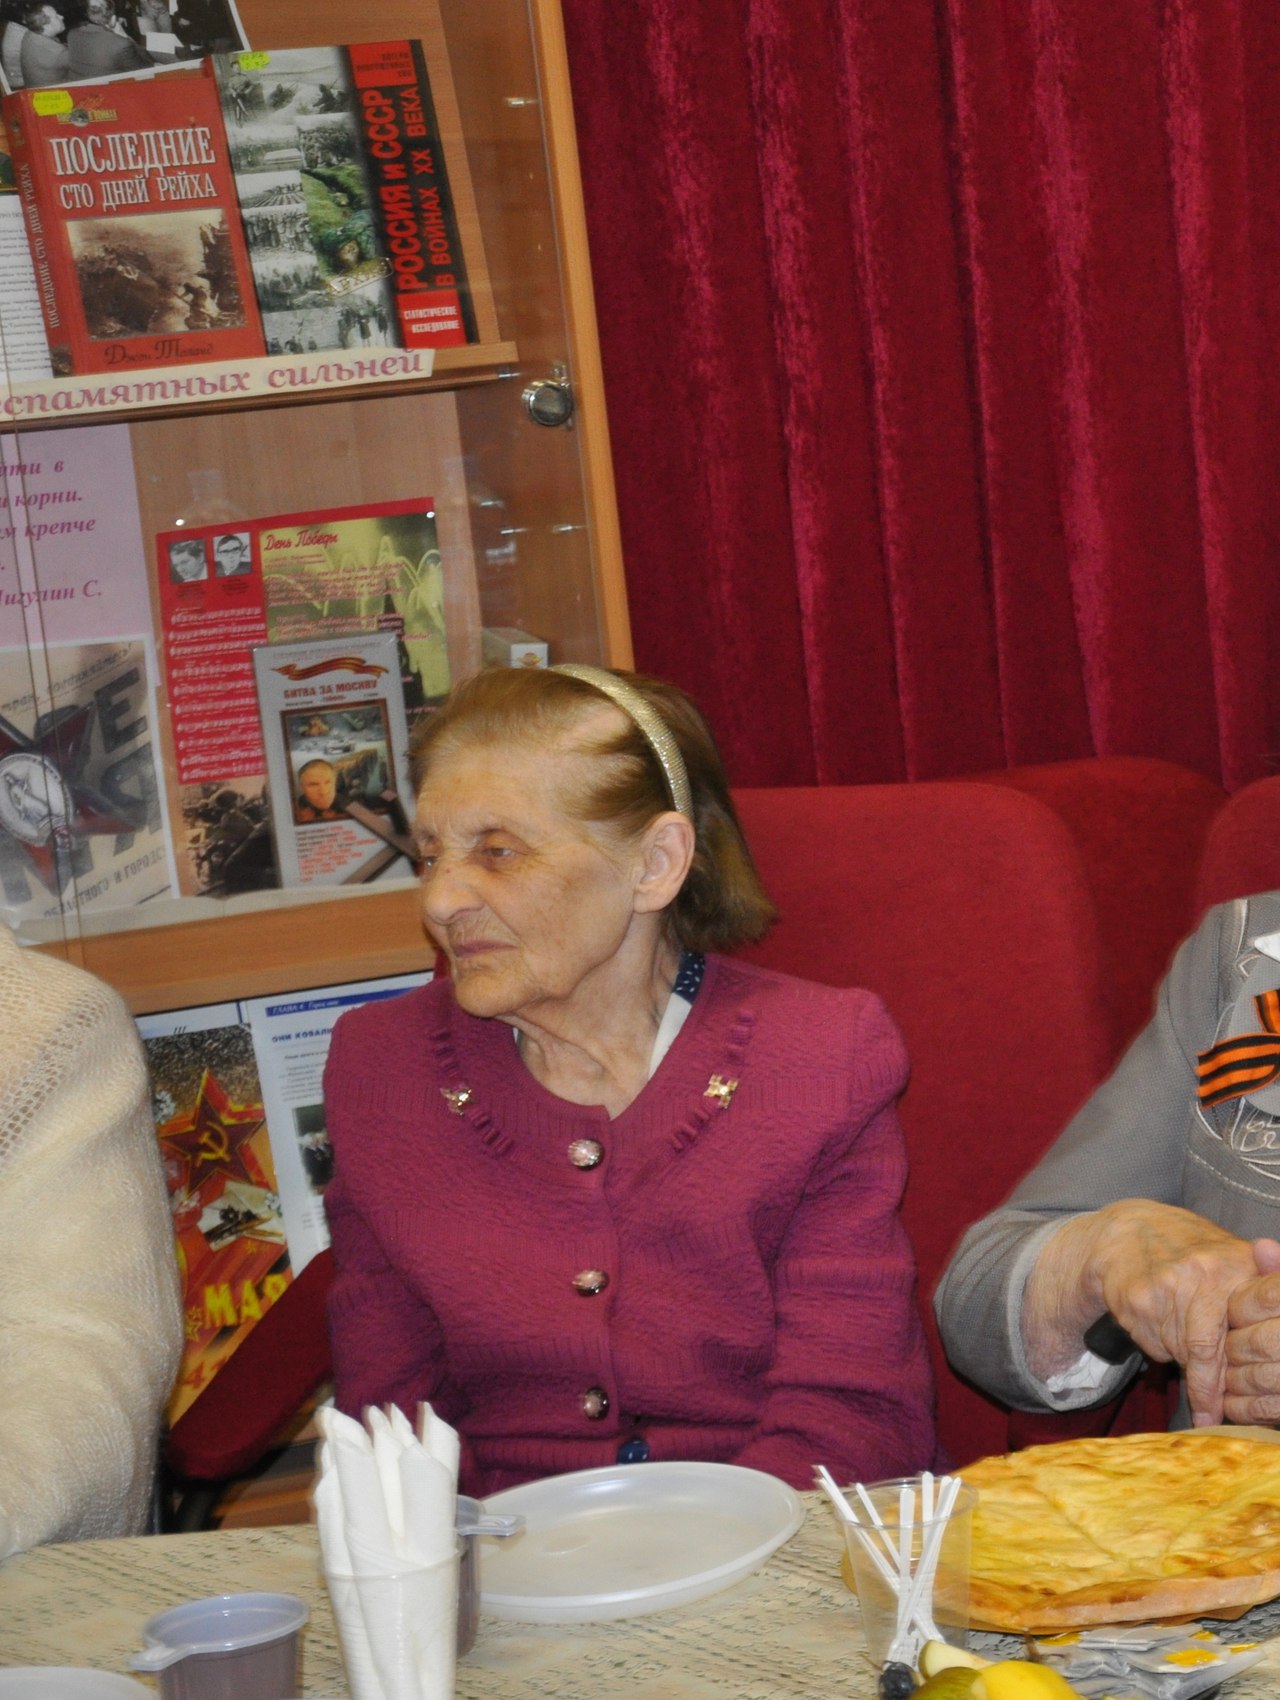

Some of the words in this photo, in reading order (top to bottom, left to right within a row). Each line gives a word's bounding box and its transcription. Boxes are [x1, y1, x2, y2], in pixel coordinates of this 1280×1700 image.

[362, 89, 403, 159] СССР
[399, 85, 427, 137] ВЕКА
[50, 126, 216, 178] ПОСЛЕДНИЕ
[59, 183, 94, 210] СТО
[100, 175, 150, 212] ДНЕЙ
[157, 171, 218, 202] РЕЙХА
[378, 184, 428, 290] РОССИЯ
[418, 186, 452, 265] ВОЙНАХ
[35, 238, 49, 260] СТО
[38, 261, 60, 329] ПОСЛЕДНИЕ
[434, 273, 456, 287] В
[0, 371, 250, 416] спамятных
[268, 348, 423, 389] сильней
[15, 490, 83, 510] корни.
[25, 519, 96, 541] крепче
[264, 534, 292, 551] День
[83, 579, 102, 598] С.
[283, 686, 316, 699] БИТВА
[336, 679, 378, 693] МОСКВУ
